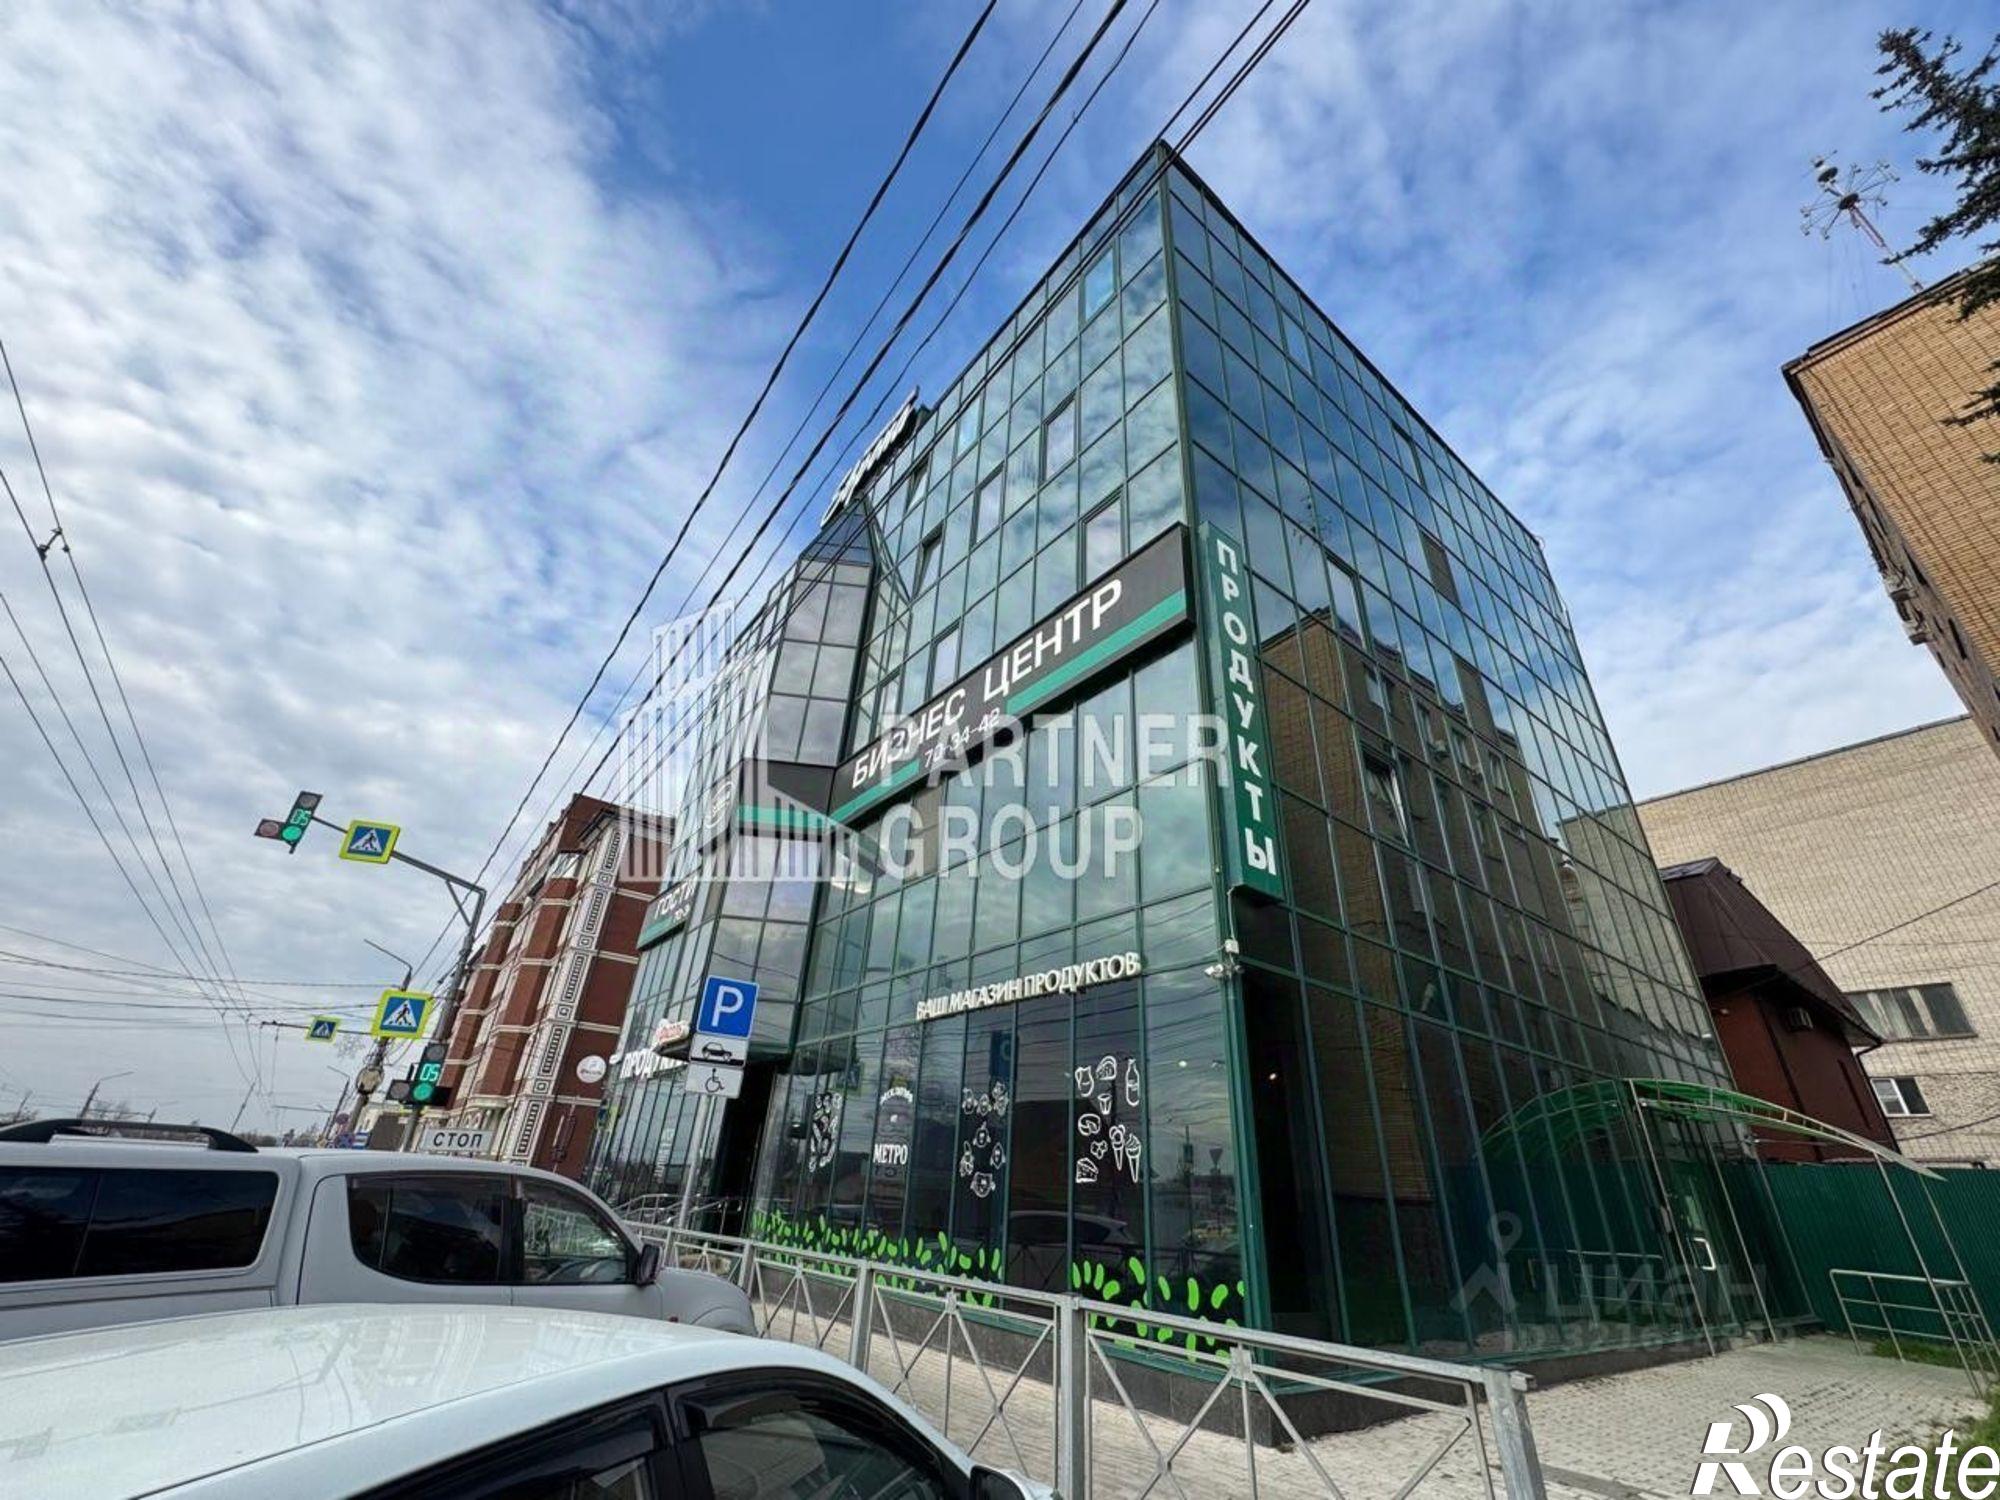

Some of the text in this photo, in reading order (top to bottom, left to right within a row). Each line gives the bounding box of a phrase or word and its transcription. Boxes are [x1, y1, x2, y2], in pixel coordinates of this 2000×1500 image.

[852, 579, 1122, 788] БИЗНЕС ЦЕНТР
[1216, 539, 1277, 876] ПРОДУКТЫ
[711, 985, 744, 1027] P
[916, 951, 1142, 1020] ВАШ МАГАЗИН ПРОДУКТОВ
[420, 1063, 441, 1082] 05
[433, 1132, 484, 1147] СТОП
[873, 1143, 909, 1165] МЕТРО
